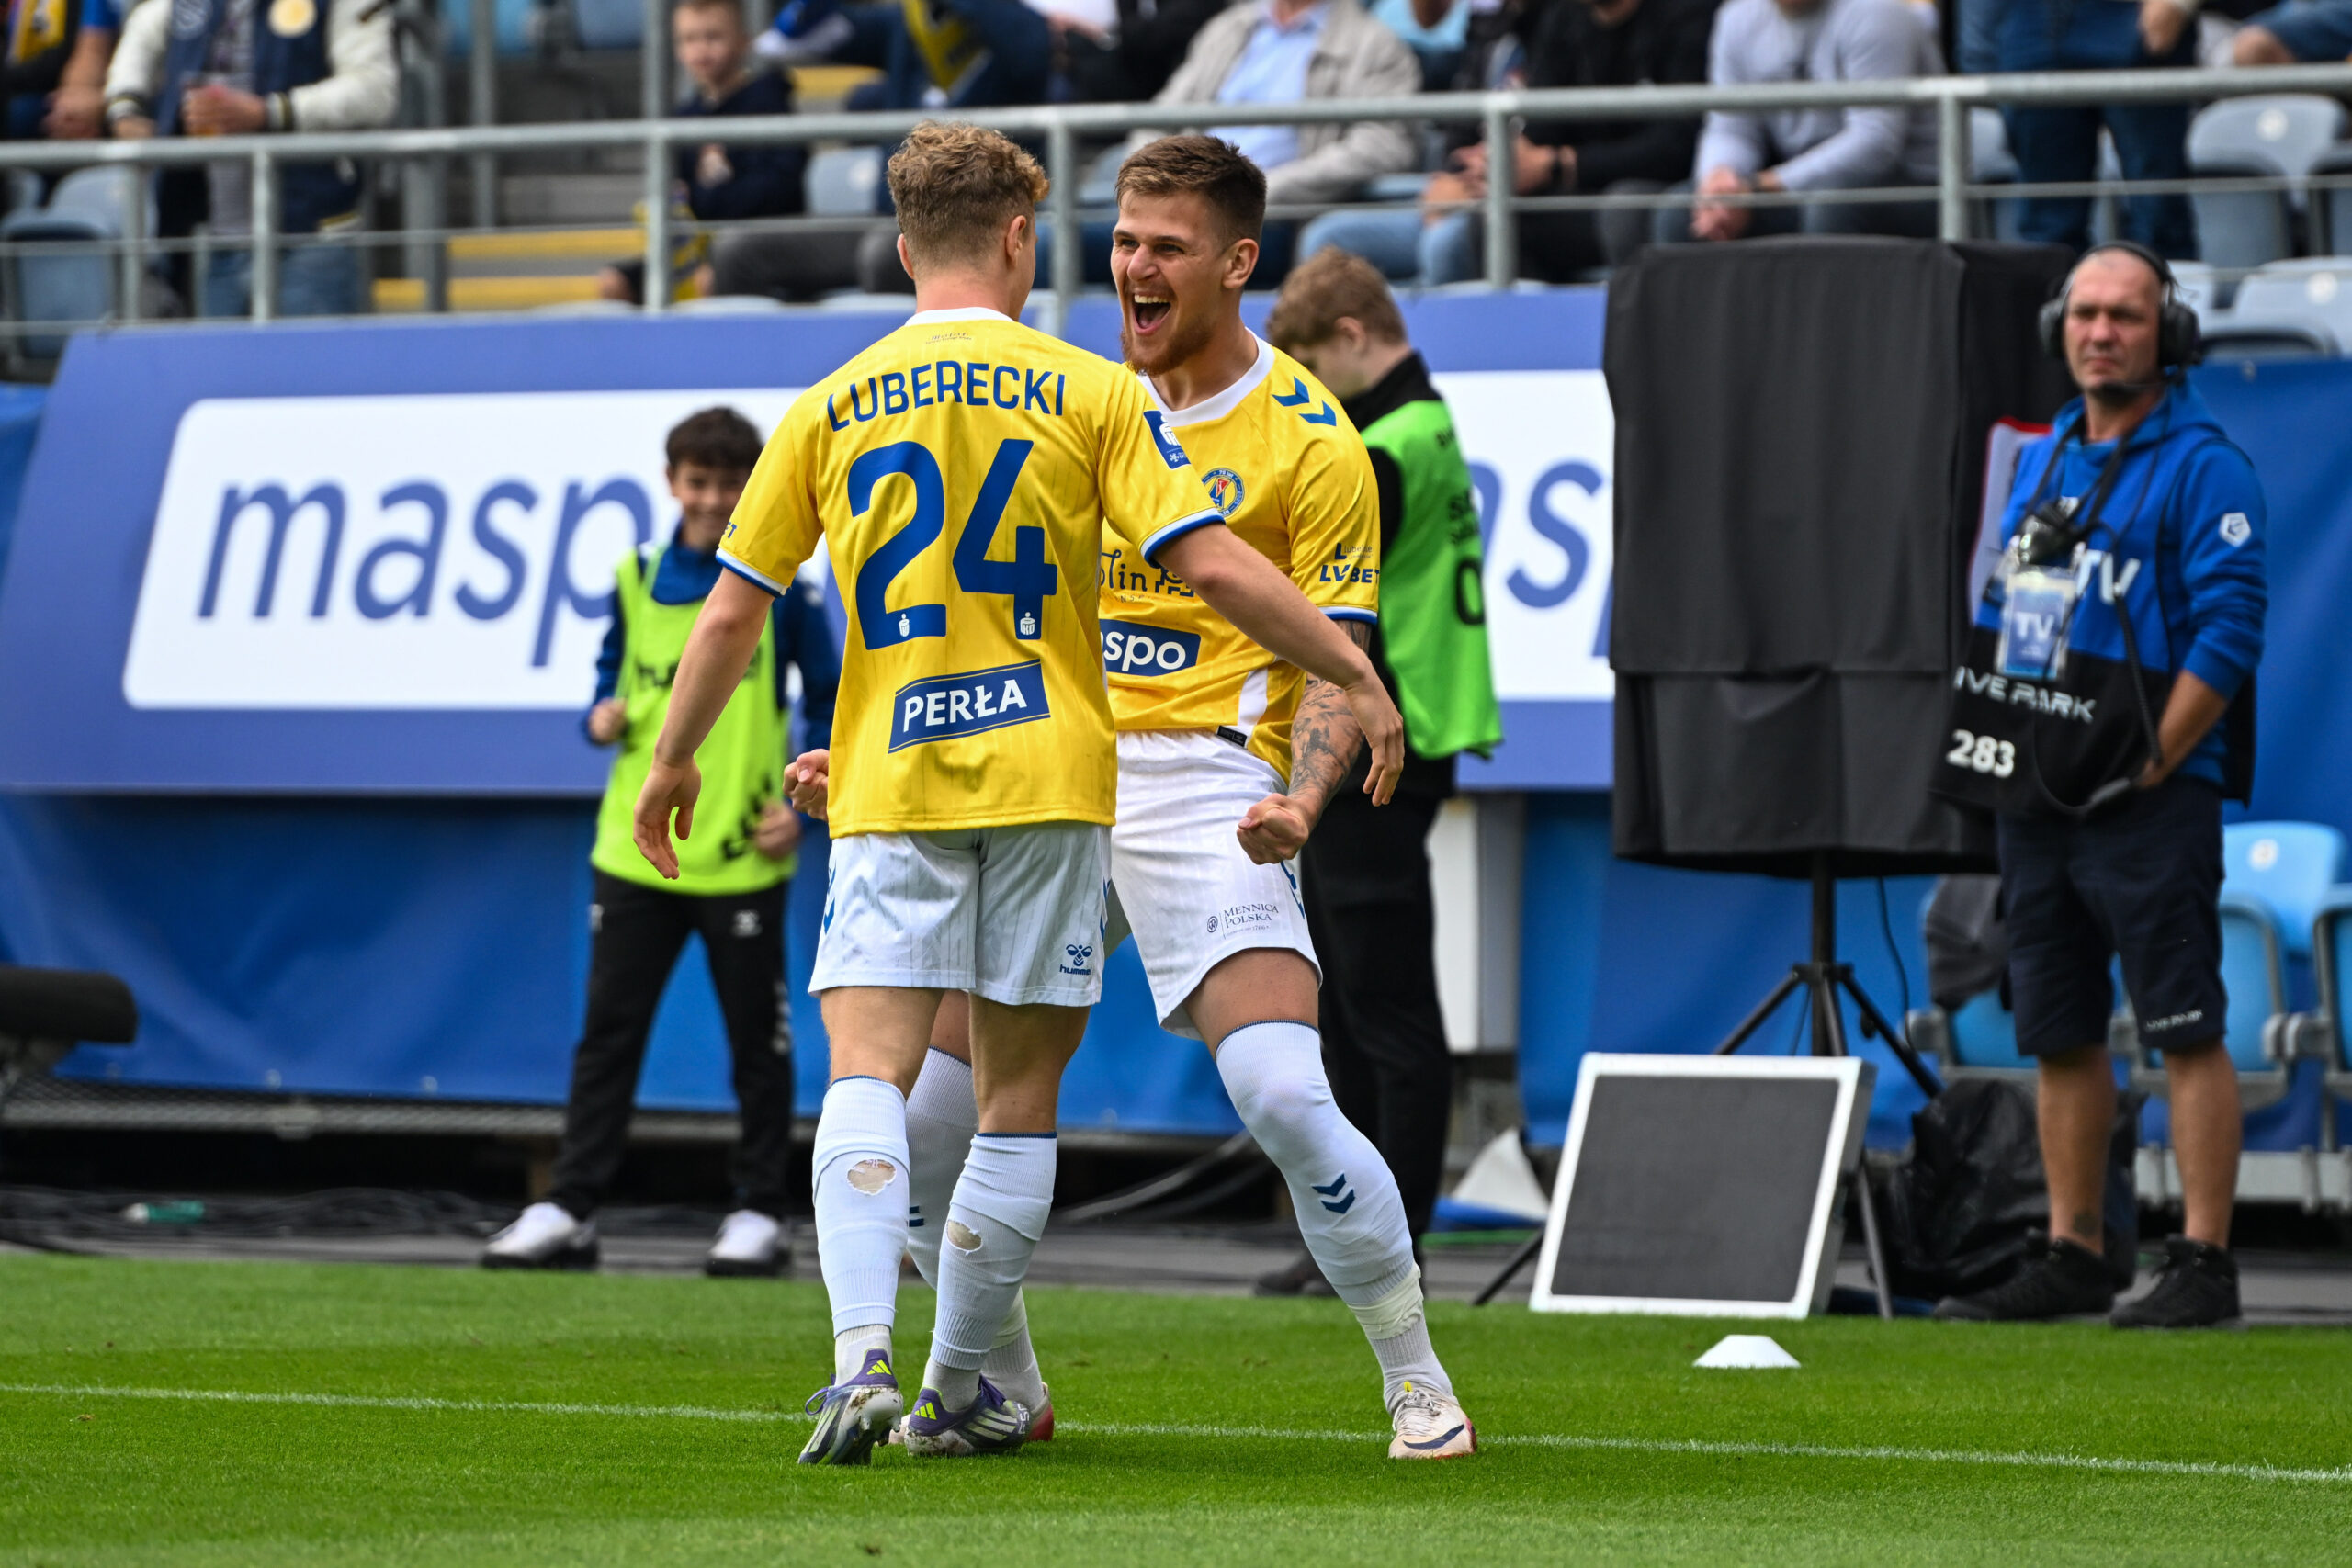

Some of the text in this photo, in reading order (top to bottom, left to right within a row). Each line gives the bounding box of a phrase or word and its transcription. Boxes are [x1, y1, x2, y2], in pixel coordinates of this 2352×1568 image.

[826, 360, 1066, 432] LUBERECKI
[847, 438, 1057, 650] 24
[197, 477, 652, 668] masp
[1100, 631, 1186, 671] spo
[1953, 665, 2008, 702] IVE
[902, 679, 1029, 733] PERŁA
[1946, 729, 2016, 778] 283
[1224, 903, 1279, 919] MENNICA
[1226, 912, 1272, 929] POLSKA
[1059, 964, 1092, 976] hummel
